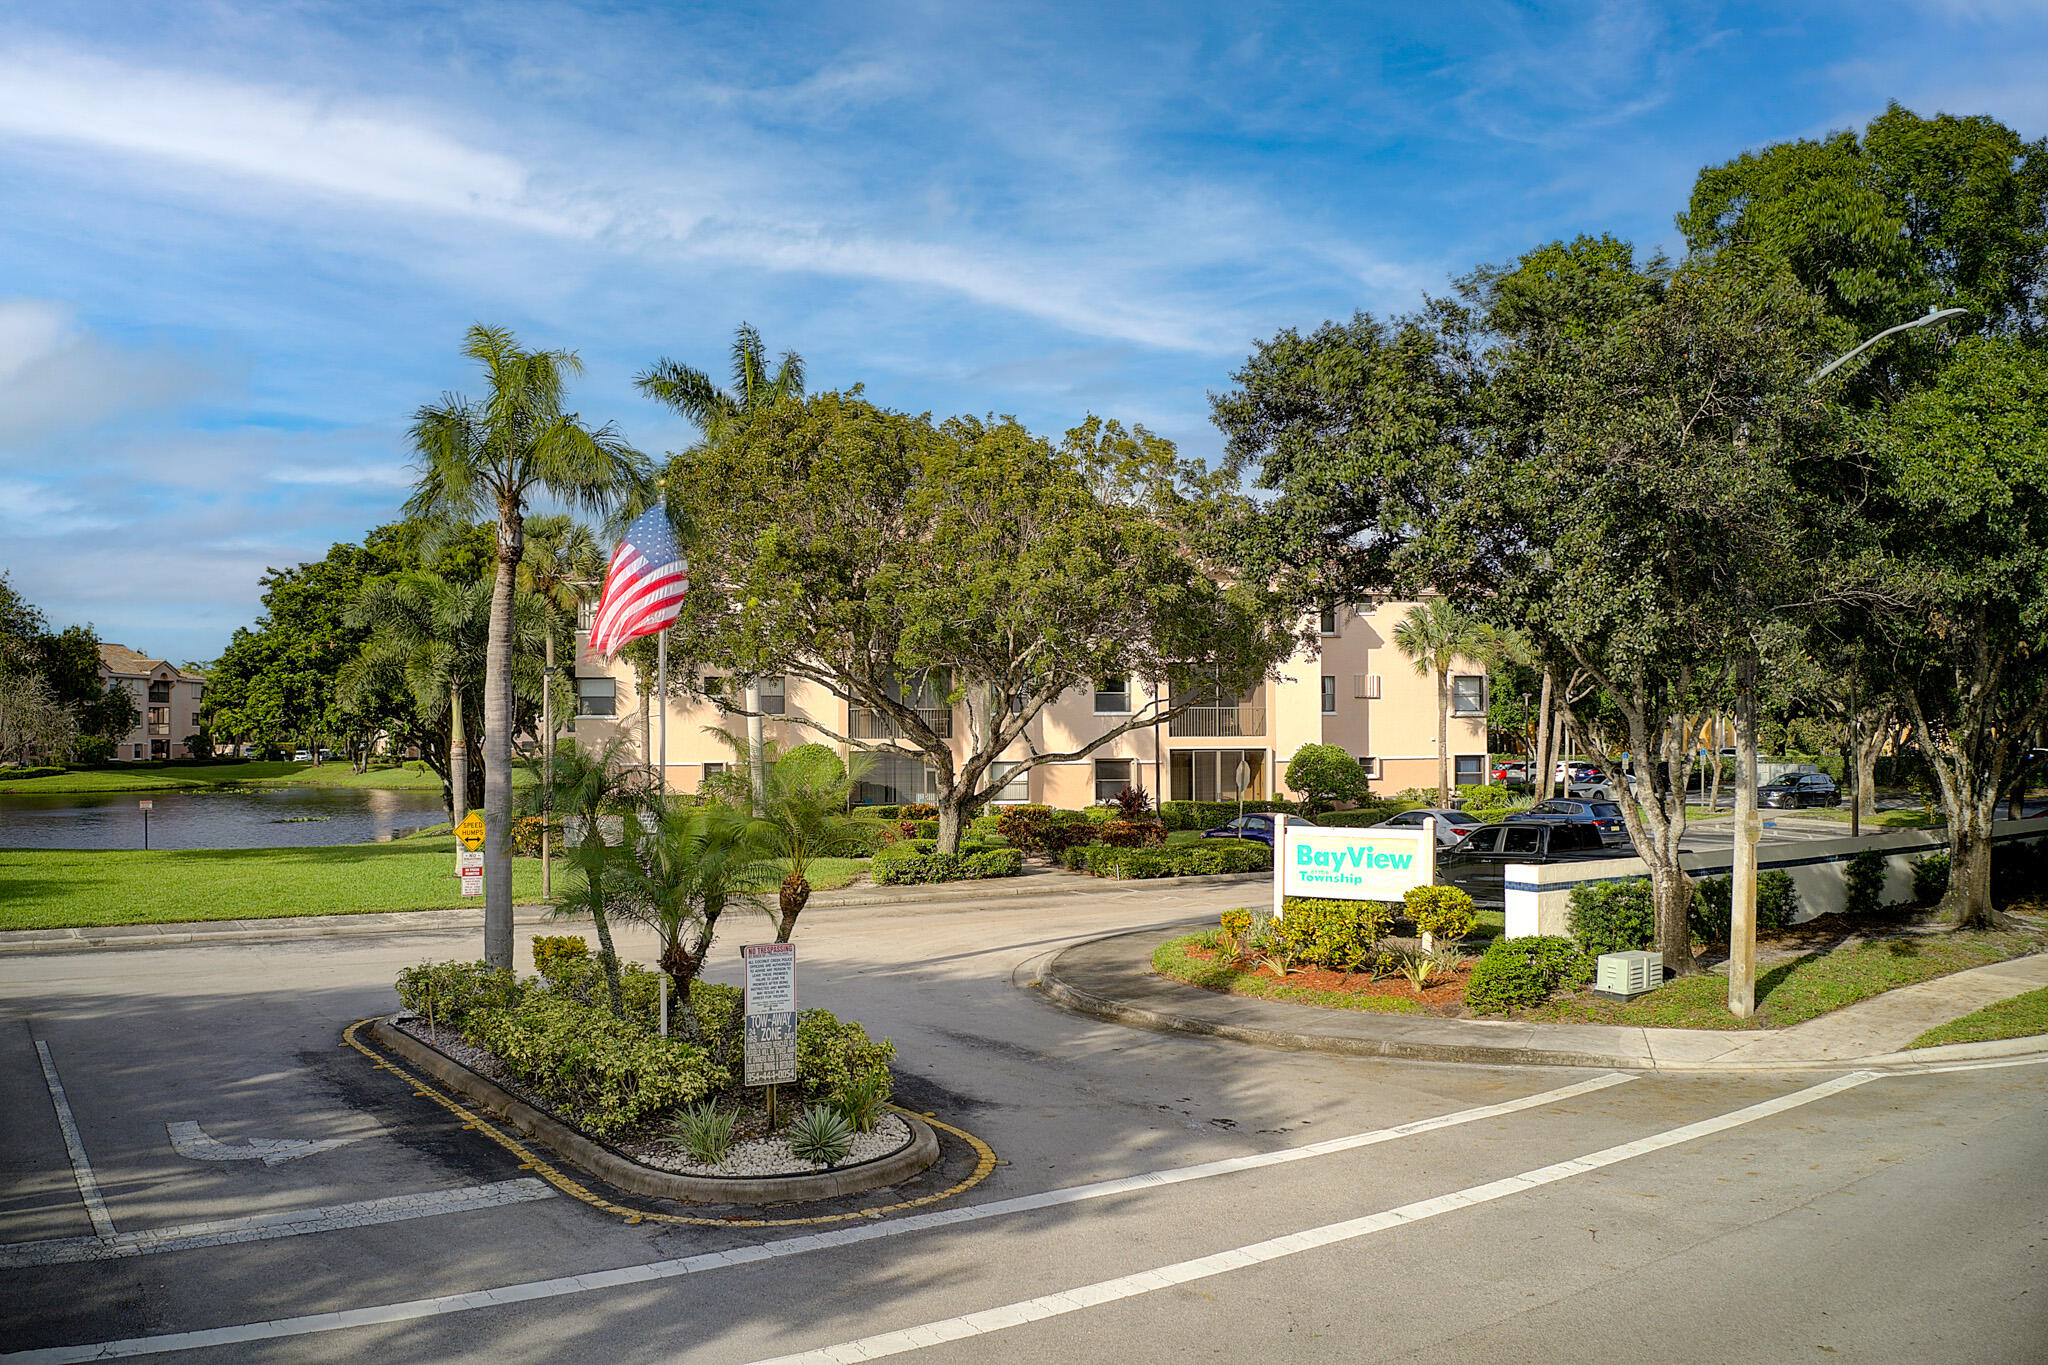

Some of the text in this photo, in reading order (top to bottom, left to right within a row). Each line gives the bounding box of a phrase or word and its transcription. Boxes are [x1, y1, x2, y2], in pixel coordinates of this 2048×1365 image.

[1299, 871, 1362, 885] Township
[757, 946, 792, 954] TRESPASSING
[751, 1012, 791, 1028] TOW-AWAY
[748, 1028, 756, 1036] 24
[761, 1026, 782, 1041] ZONE
[784, 1032, 794, 1040] DAYS
